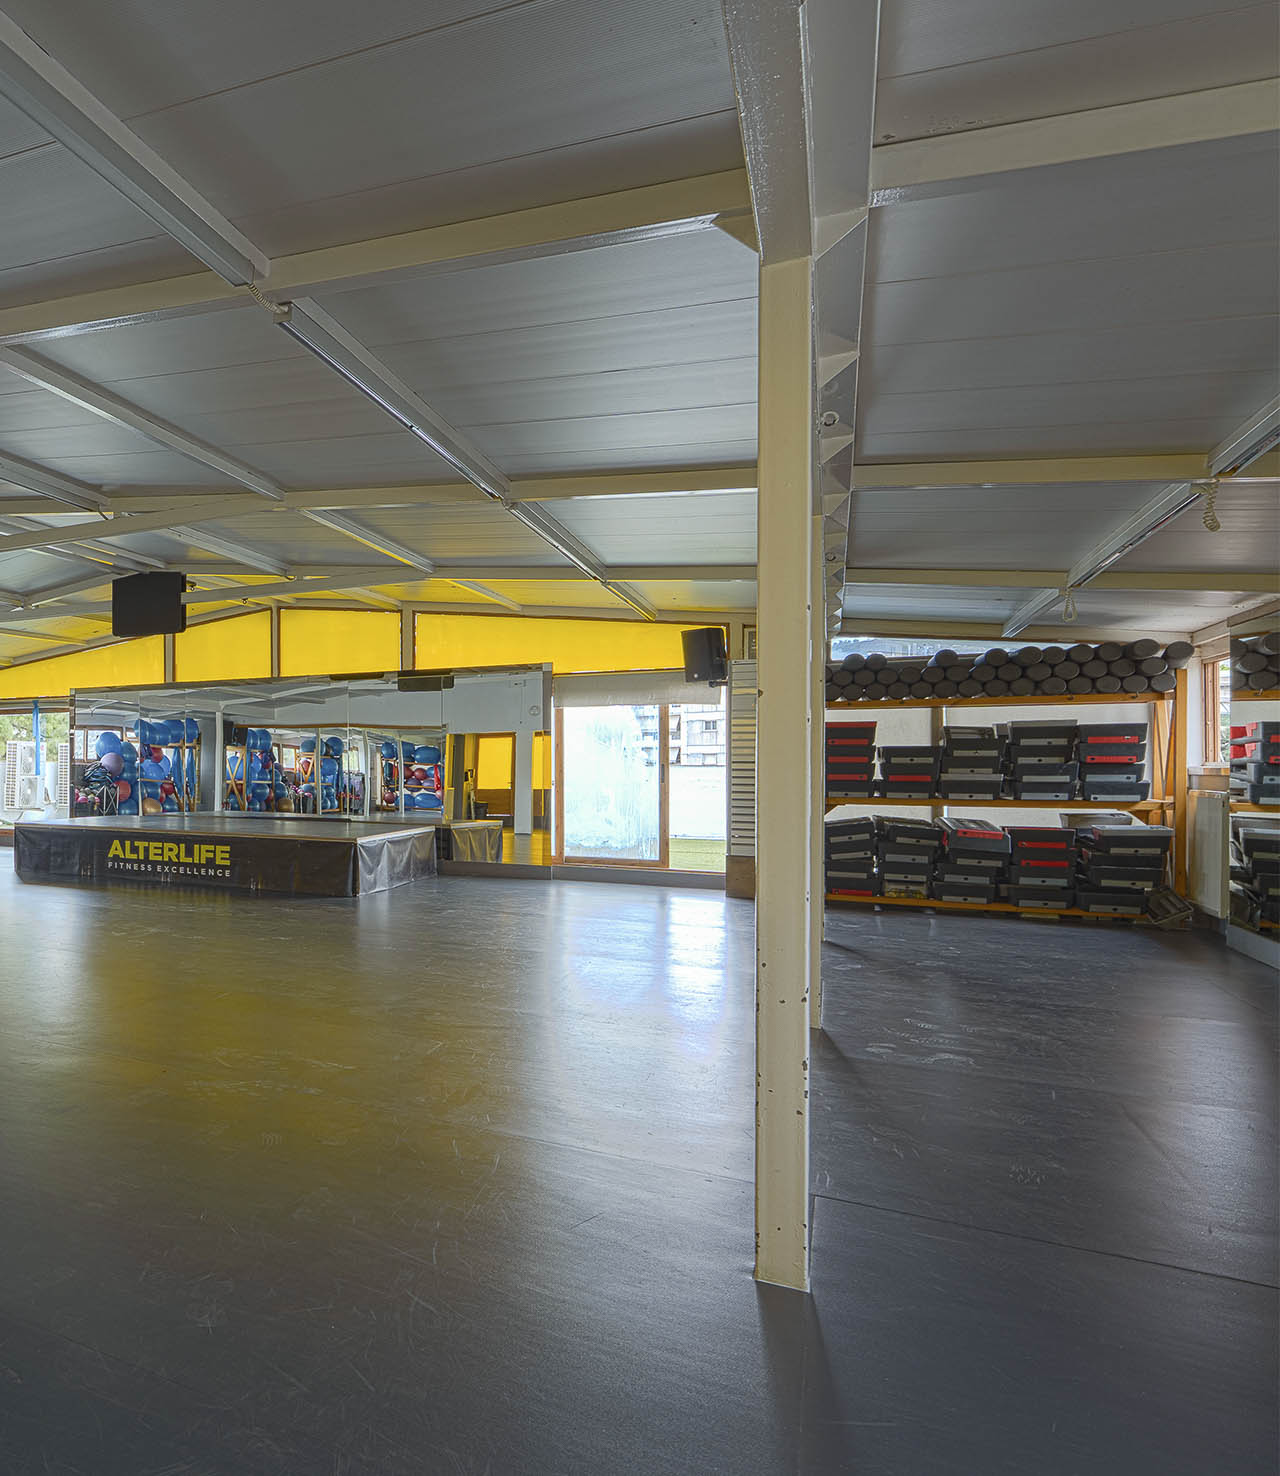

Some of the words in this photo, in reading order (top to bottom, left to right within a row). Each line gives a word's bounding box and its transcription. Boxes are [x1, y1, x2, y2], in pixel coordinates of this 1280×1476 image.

[108, 840, 231, 866] ALTERLIFE
[108, 861, 153, 872] FITNESS
[157, 865, 231, 877] EXCELLENCE
